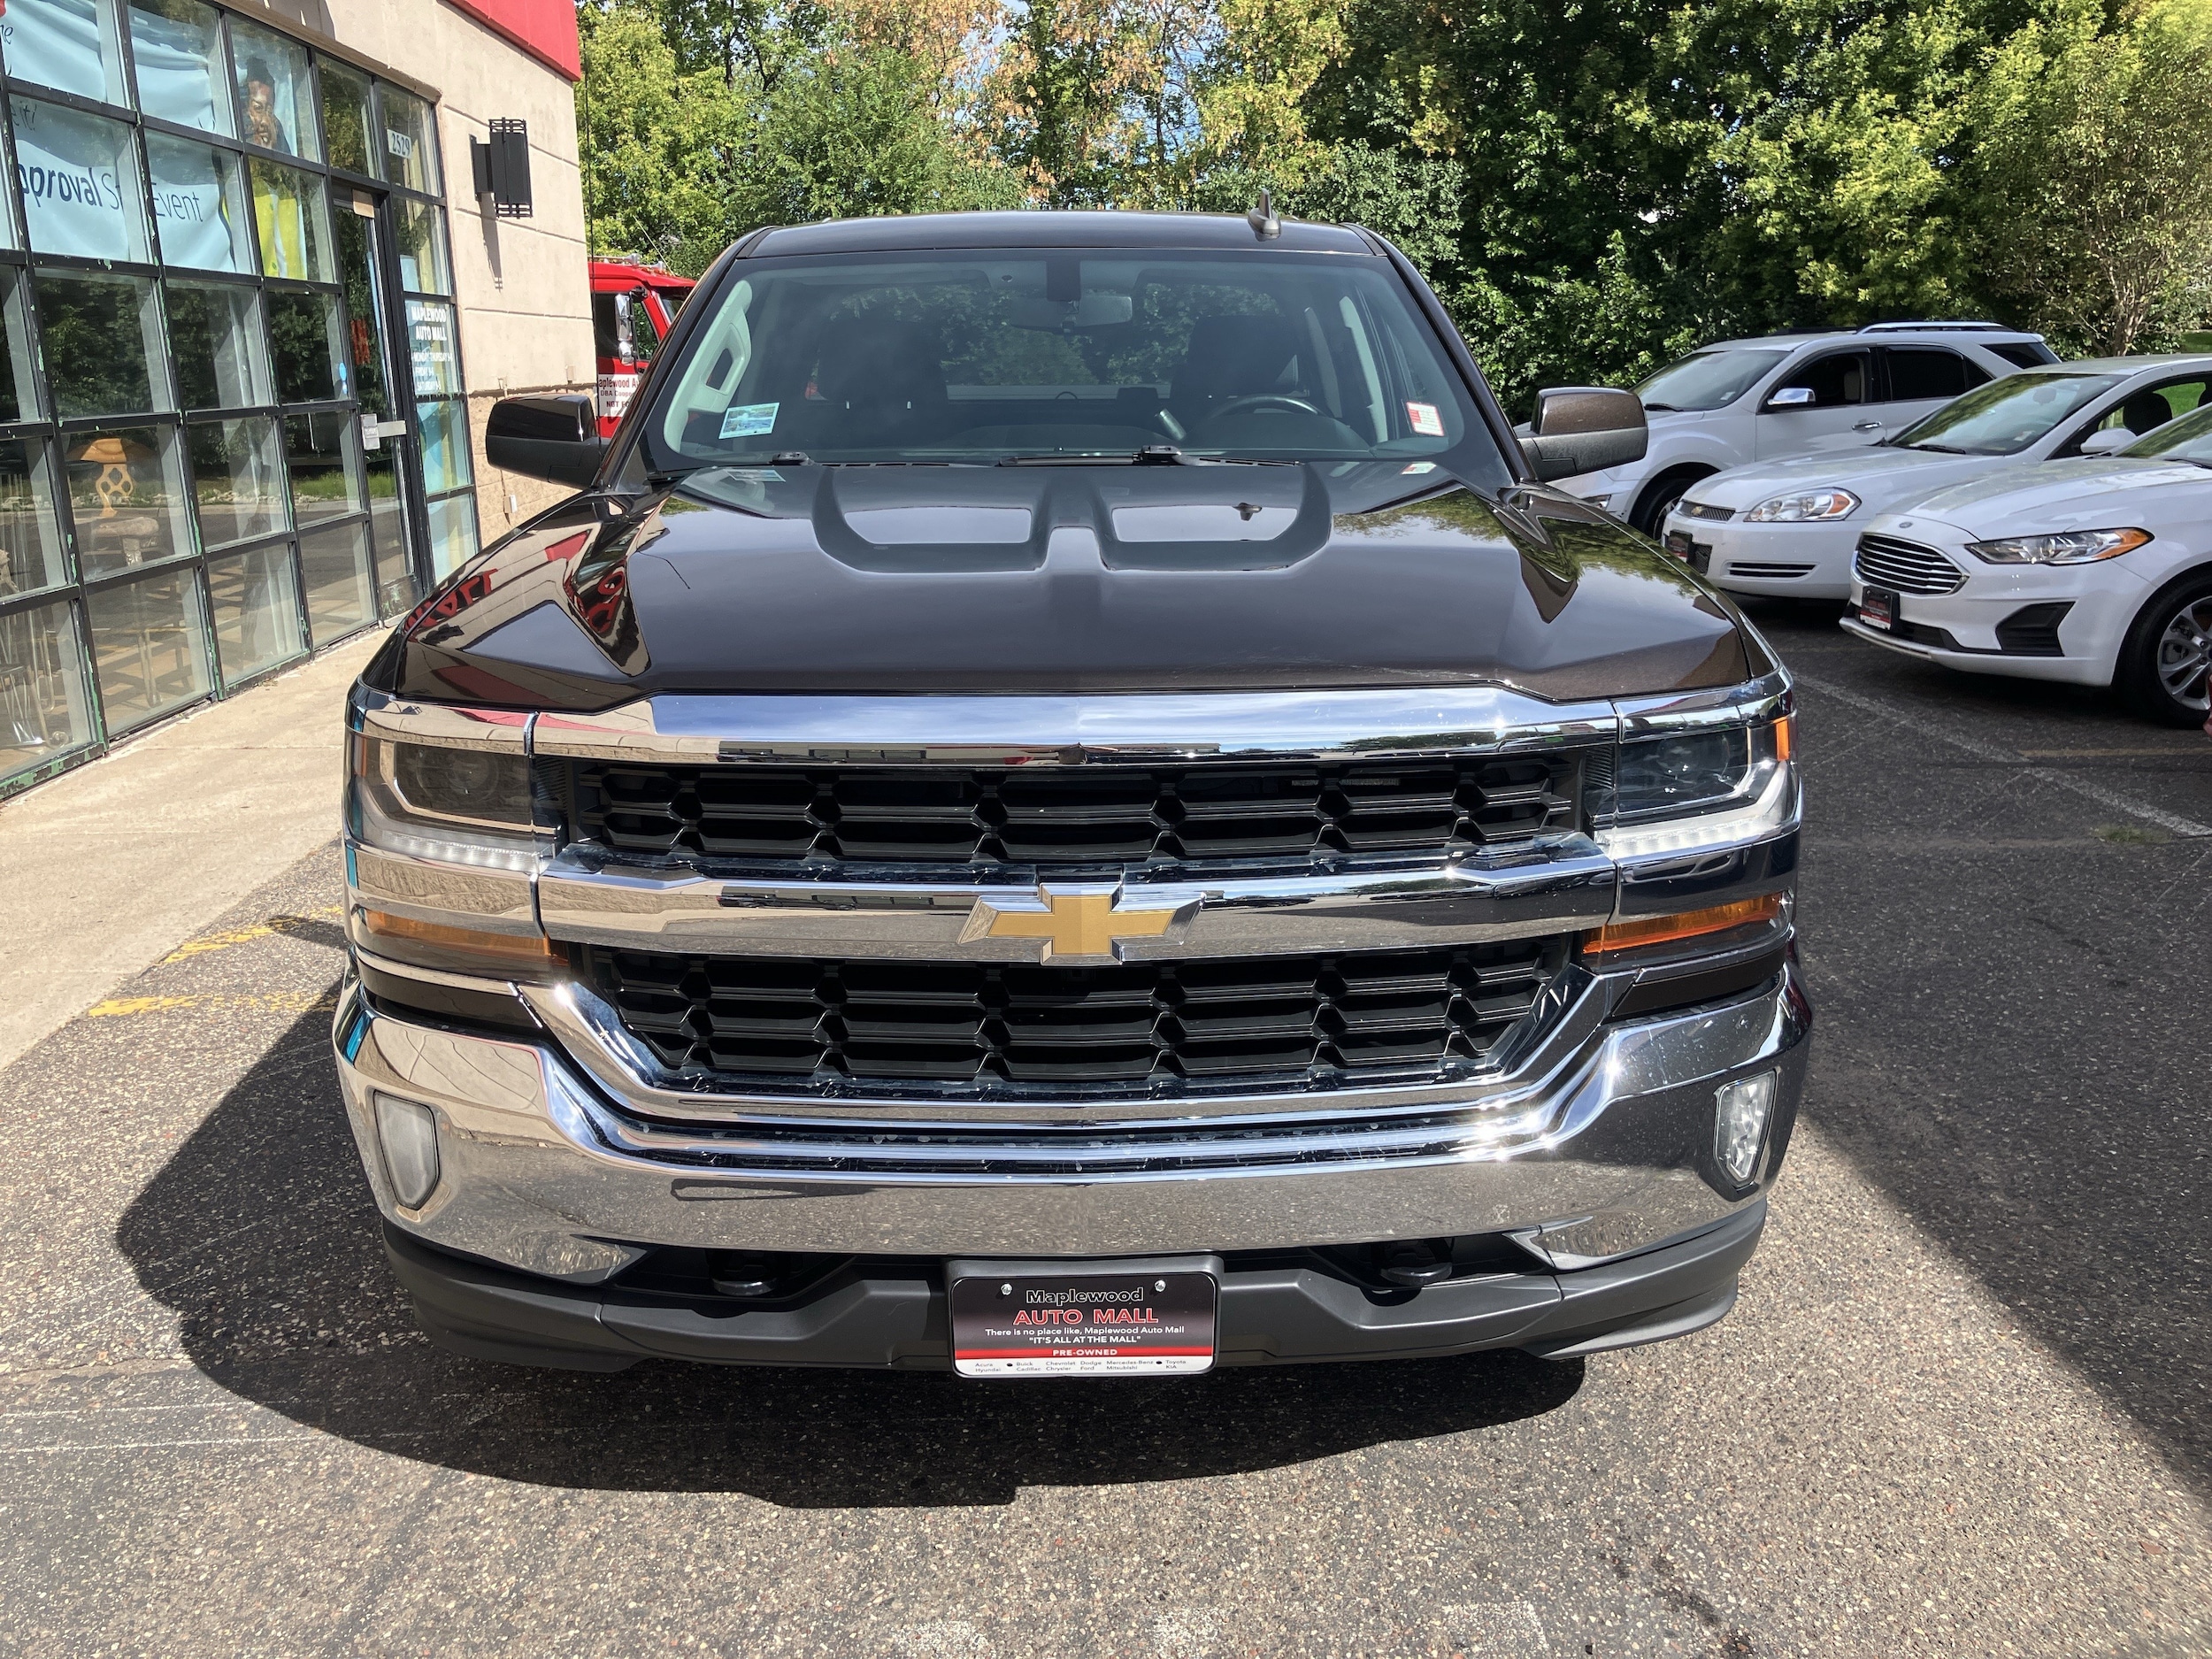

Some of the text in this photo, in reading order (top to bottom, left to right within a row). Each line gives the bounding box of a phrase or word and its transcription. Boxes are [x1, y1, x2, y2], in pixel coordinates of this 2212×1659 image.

[391, 133, 411, 157] 2529
[18, 163, 104, 208] pproval
[411, 306, 446, 322] MAPLEWOOD
[415, 326, 447, 341] AUTO MALL
[598, 377, 630, 390] aplewood
[1026, 1286, 1144, 1307] Maplewood
[1013, 1308, 1159, 1325] AUTO MALL
[1037, 1327, 1062, 1336] place
[1085, 1326, 1139, 1335] Maplewood
